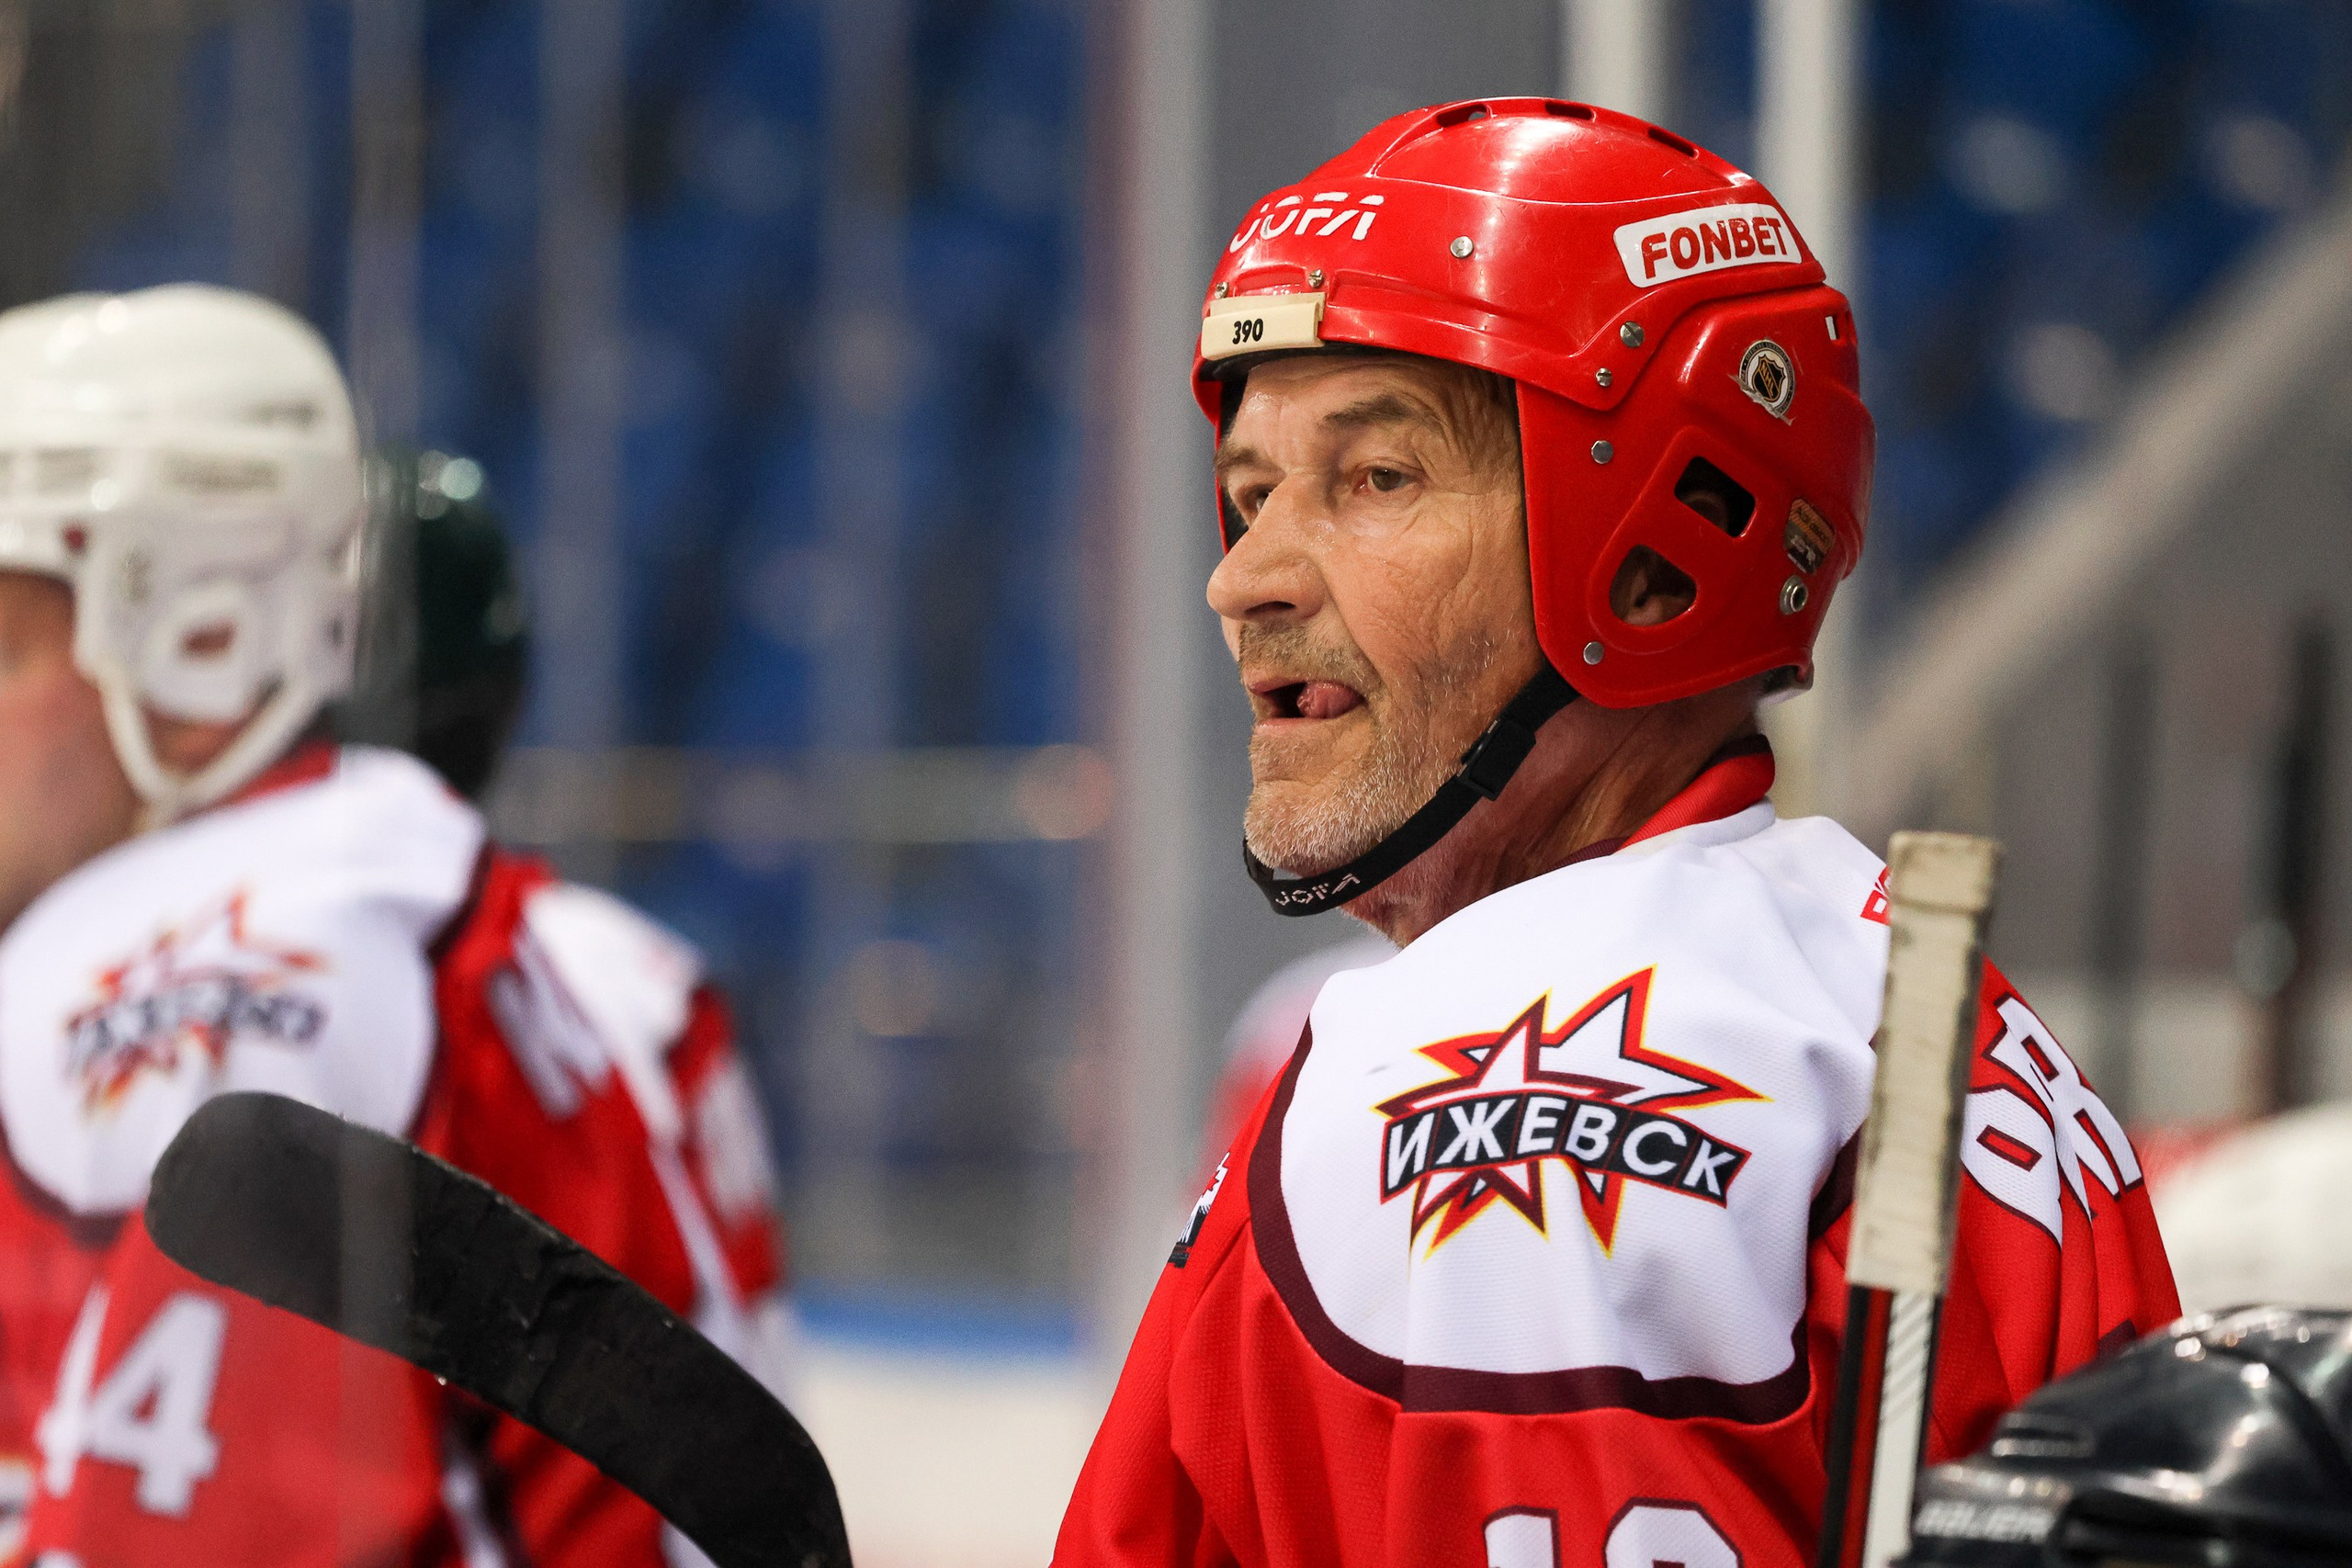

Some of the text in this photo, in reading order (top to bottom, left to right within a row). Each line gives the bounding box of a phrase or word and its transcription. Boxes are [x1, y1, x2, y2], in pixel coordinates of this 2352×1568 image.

[1228, 191, 1385, 254] JOFA
[1641, 216, 1788, 280] FONBET
[1232, 318, 1264, 345] 390
[1274, 873, 1361, 907] JOFA
[1386, 1093, 1736, 1196] ИЖЕВСК
